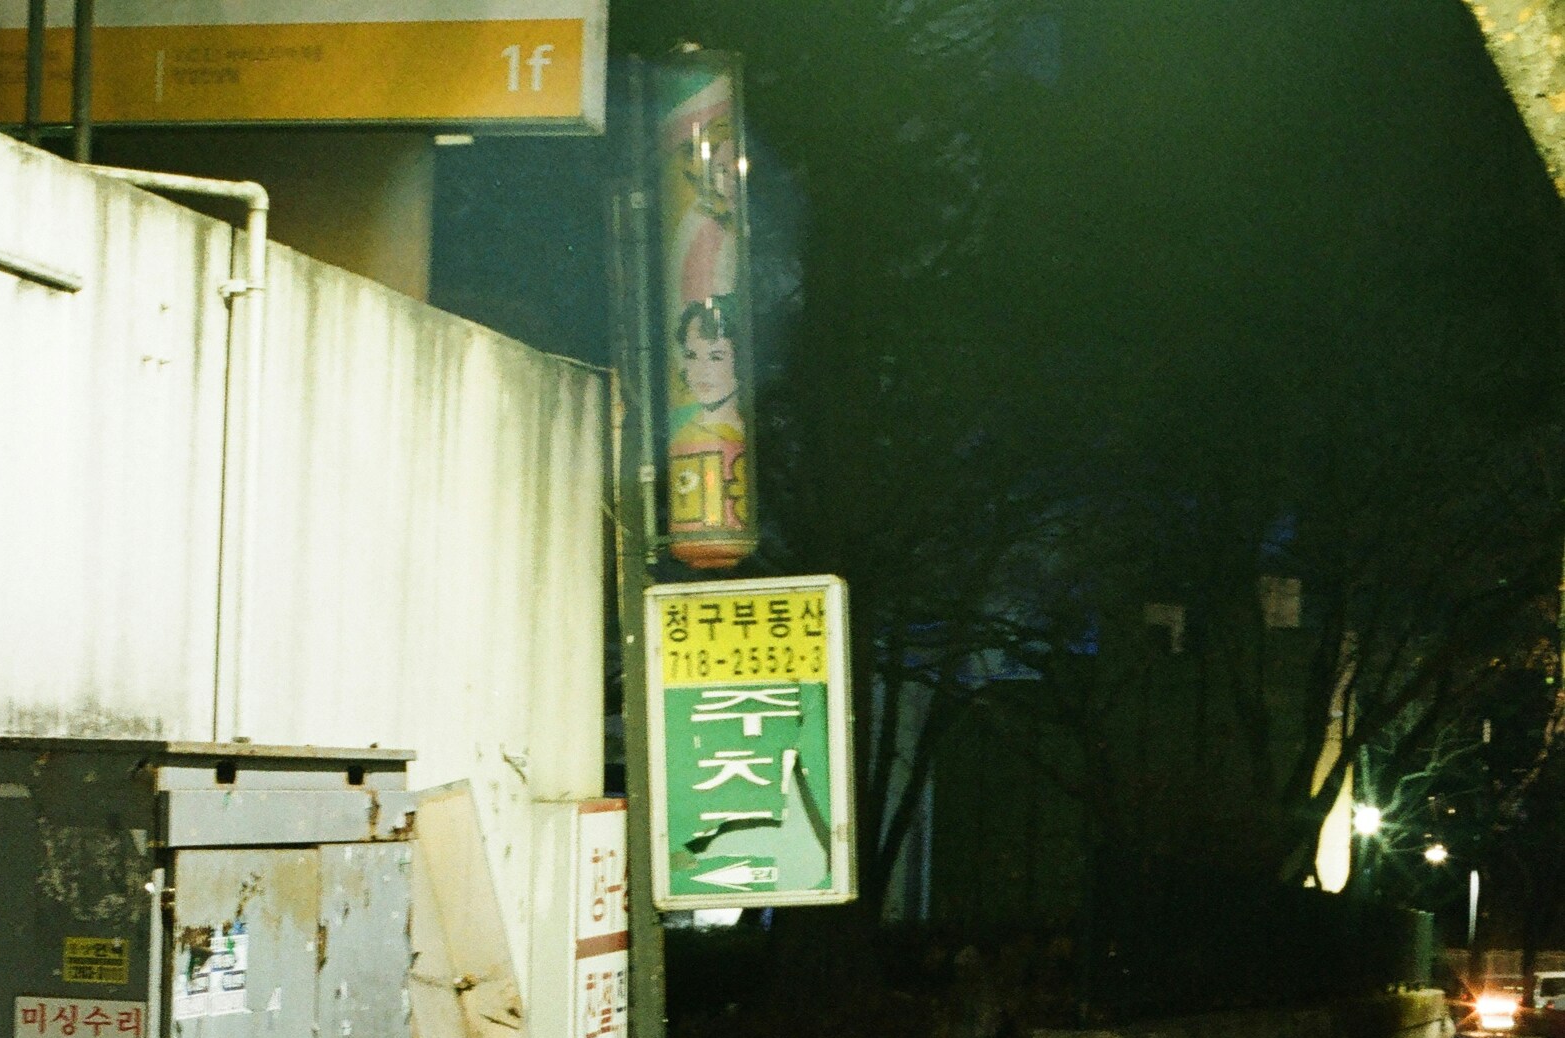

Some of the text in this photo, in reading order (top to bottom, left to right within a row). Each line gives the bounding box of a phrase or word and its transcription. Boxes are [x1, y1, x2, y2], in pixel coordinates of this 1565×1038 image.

[500, 44, 555, 93] 1f
[666, 597, 824, 643] 청구부동산
[20, 1002, 142, 1038] 미싱수리
